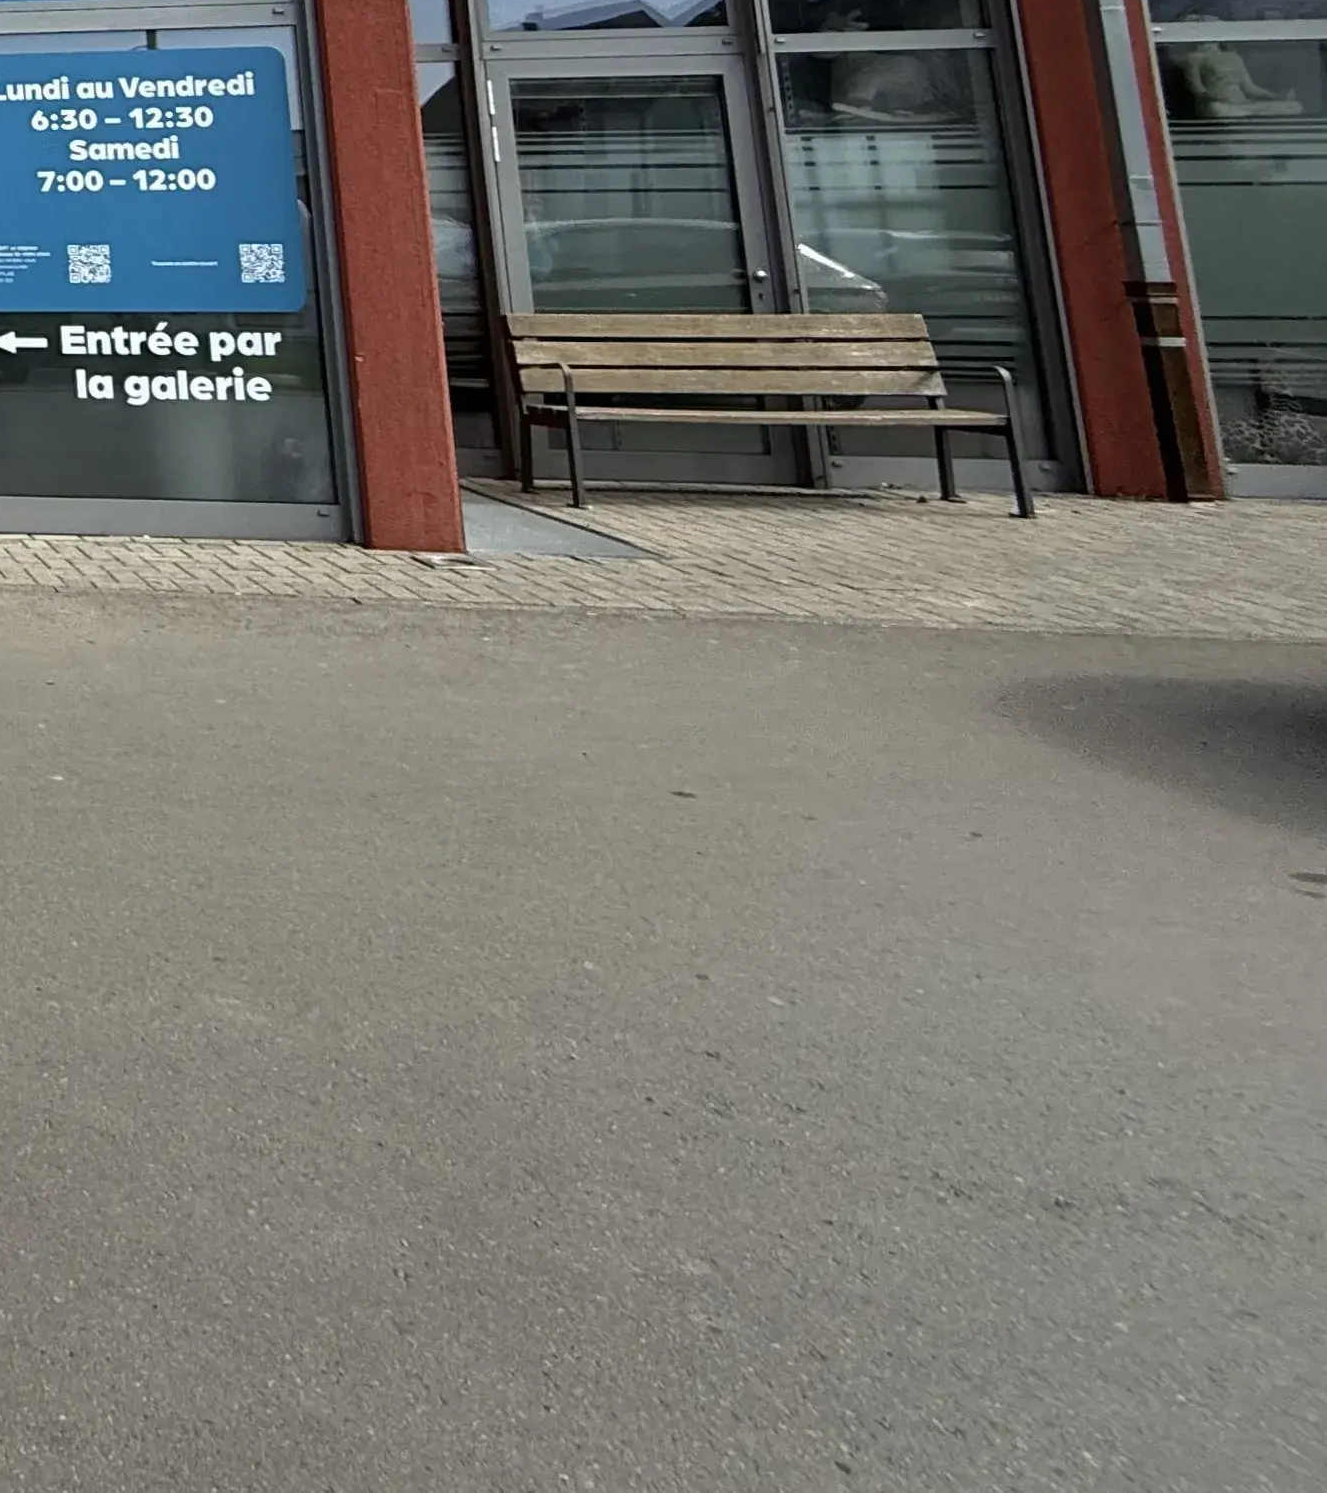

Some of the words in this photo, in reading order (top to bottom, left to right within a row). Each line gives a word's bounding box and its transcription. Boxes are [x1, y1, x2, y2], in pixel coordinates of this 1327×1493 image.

[76, 80, 114, 100] au
[118, 71, 255, 99] Vendredi
[31, 109, 98, 131] 6:30
[129, 106, 214, 129] 12:30
[69, 135, 180, 161] Samedi
[37, 170, 104, 192] 7:00
[132, 168, 216, 191] 12:00
[60, 321, 199, 355] Entrée
[209, 331, 282, 361] par
[76, 369, 114, 399] la
[124, 367, 273, 406] galerie
